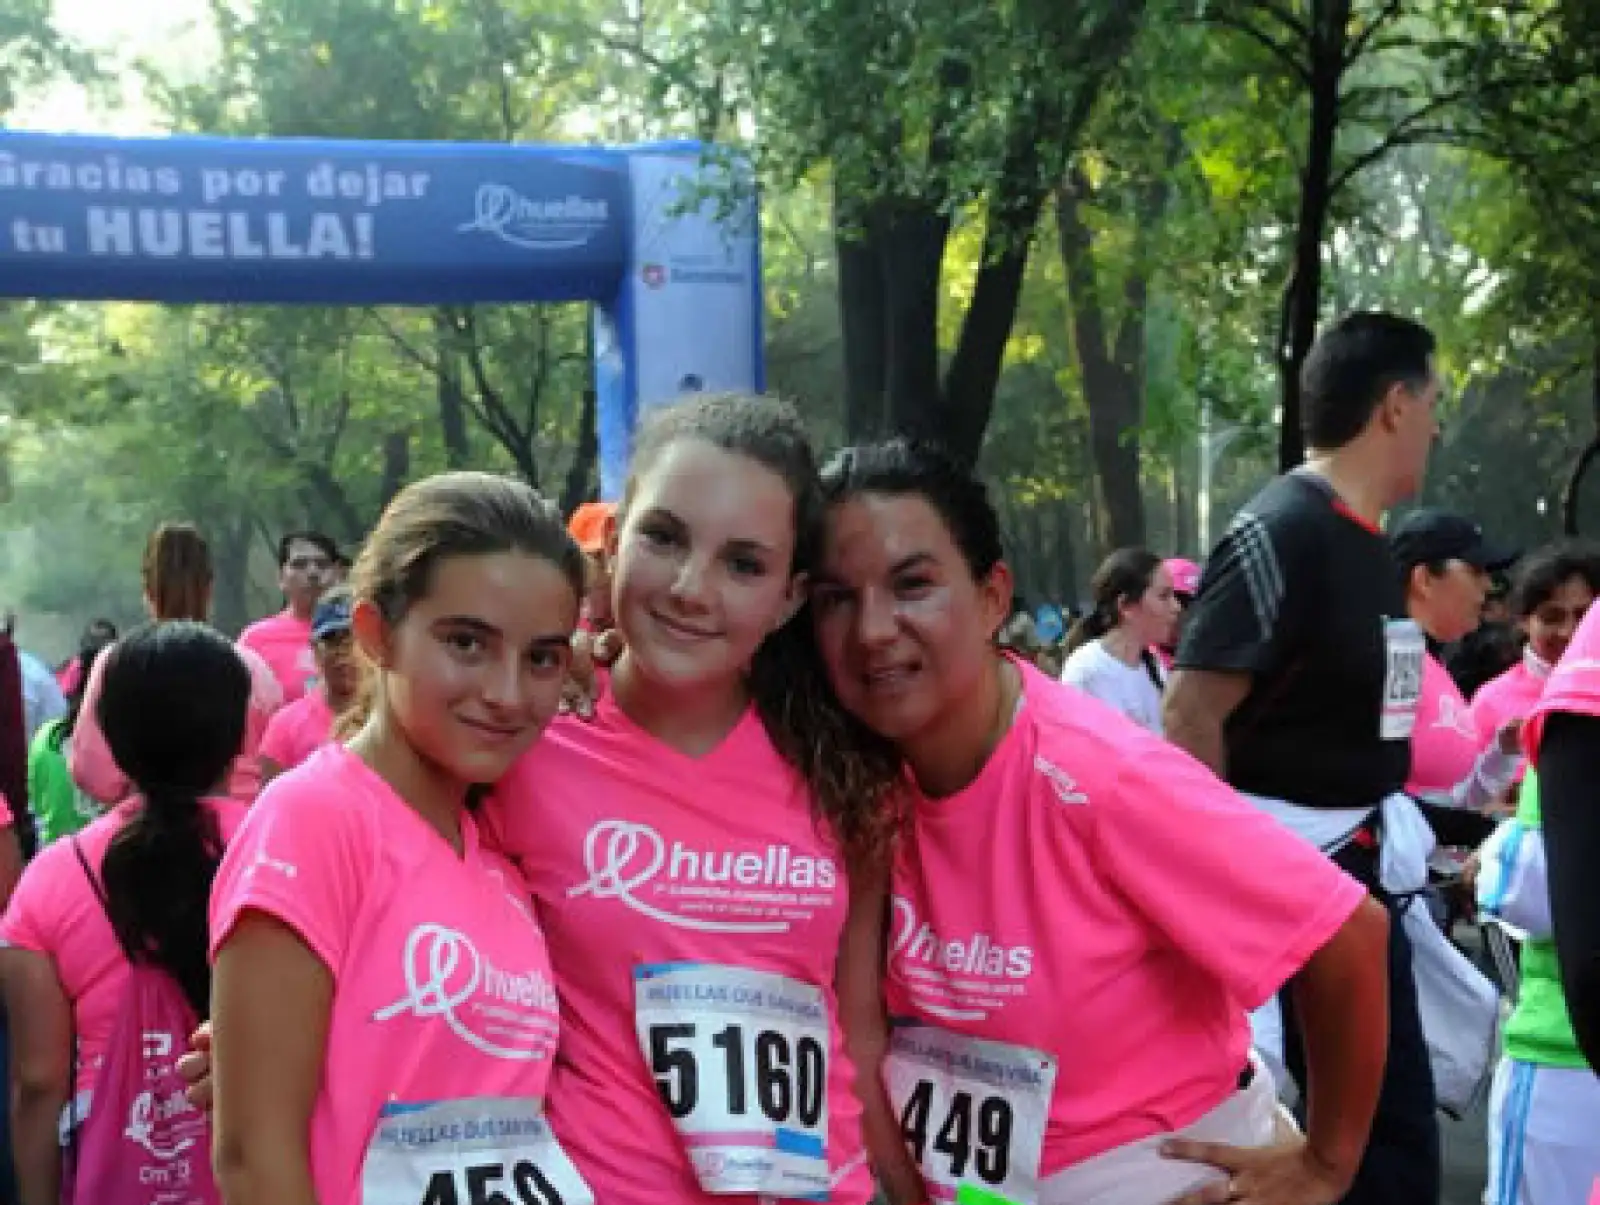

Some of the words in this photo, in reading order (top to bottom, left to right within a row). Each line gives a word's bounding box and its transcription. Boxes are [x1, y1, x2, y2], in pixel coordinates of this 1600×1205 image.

[203, 164, 286, 203] por
[307, 162, 431, 206] dejar
[12, 216, 66, 253] tu
[87, 205, 375, 260] HUELLA!
[669, 841, 836, 888] huellas
[905, 924, 1034, 978] hellas
[483, 958, 559, 1012] huella
[647, 1022, 825, 1128] 5160
[901, 1079, 1013, 1184] 449
